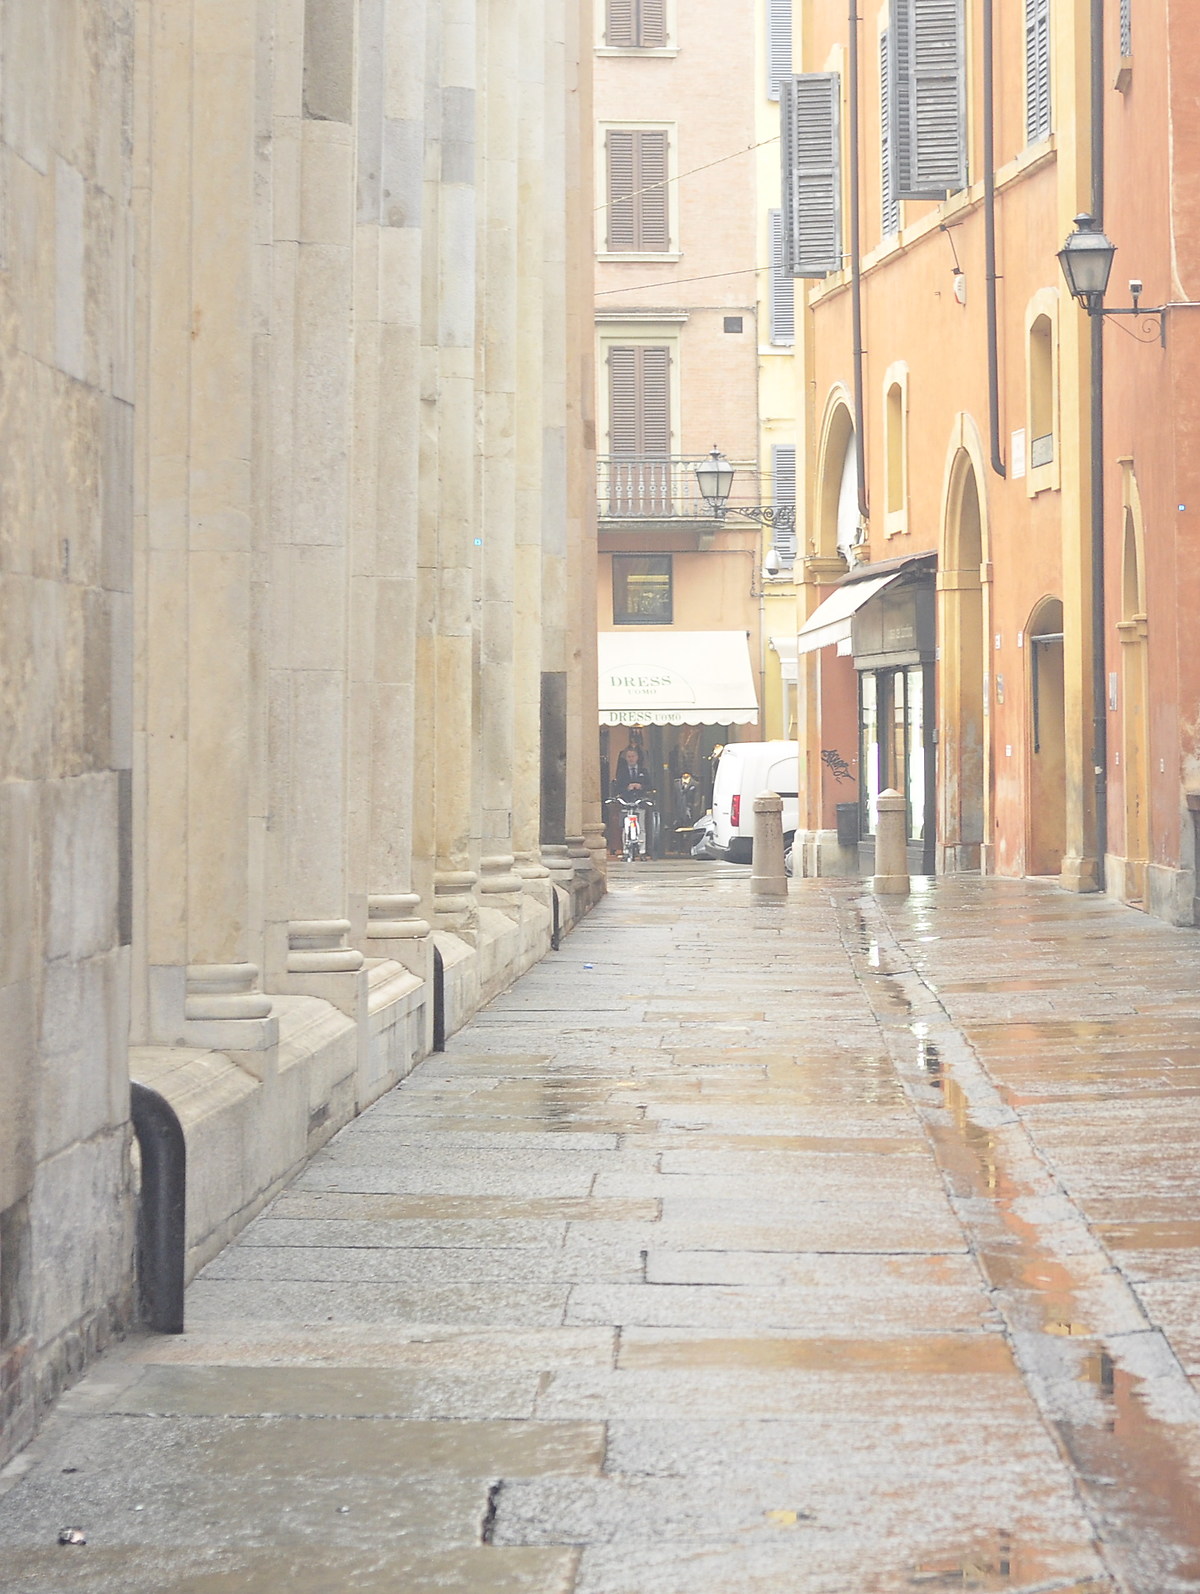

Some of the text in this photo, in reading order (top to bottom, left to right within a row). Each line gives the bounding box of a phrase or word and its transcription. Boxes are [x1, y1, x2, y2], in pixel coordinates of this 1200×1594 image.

[611, 675, 671, 687] DRESS
[610, 711, 681, 722] DRESS UOMO
